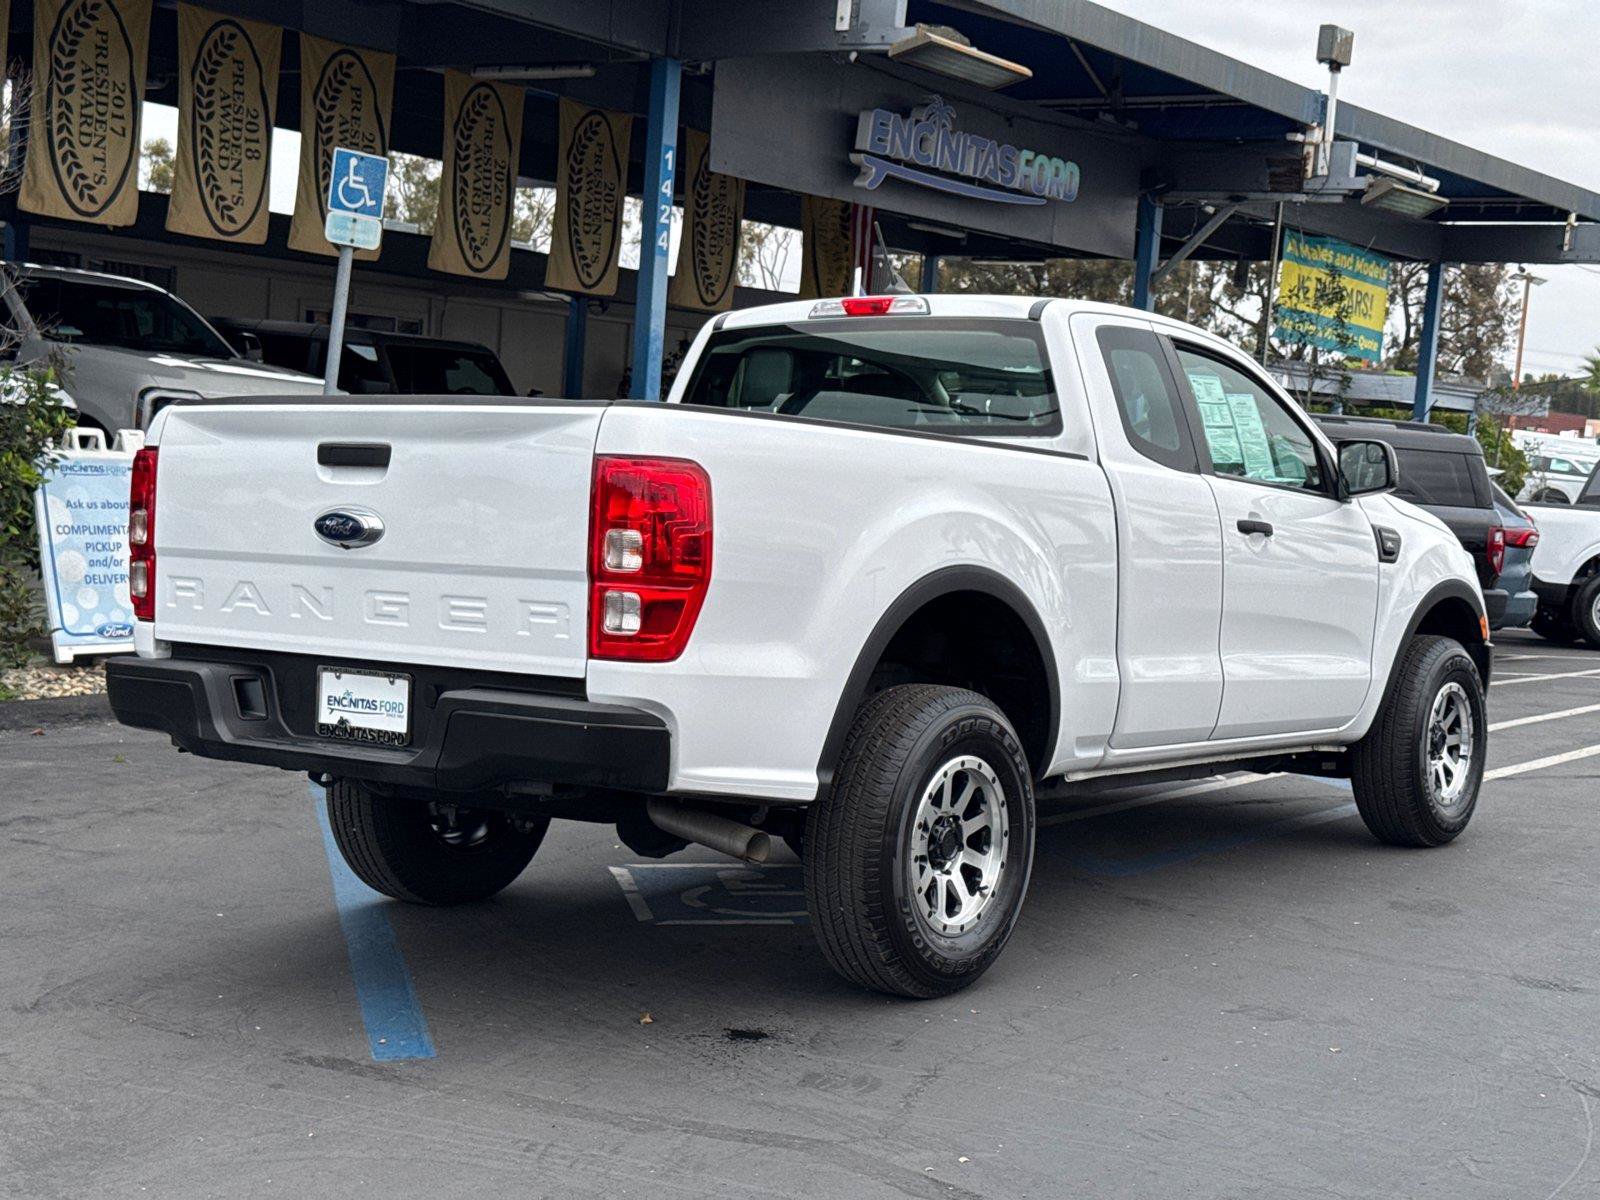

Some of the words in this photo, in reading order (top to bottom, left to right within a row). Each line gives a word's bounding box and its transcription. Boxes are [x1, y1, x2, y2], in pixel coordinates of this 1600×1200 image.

[79, 60, 95, 148] AWARD
[92, 29, 110, 186] PRESIDENT'S
[110, 82, 128, 138] 2017
[218, 88, 231, 171] AWARD
[231, 59, 246, 207] PRESIDENT'S
[245, 108, 261, 161] 2018
[864, 107, 1019, 189] ENCINITAS
[1018, 149, 1081, 203] FORD
[471, 142, 483, 216] AWARD
[479, 116, 495, 247] PRESIDENT'S
[582, 169, 595, 235] AWARD
[591, 142, 605, 264] PRESIDENT'S
[603, 181, 616, 226] 2021
[656, 149, 675, 252] 1424
[1335, 251, 1353, 270] and
[1355, 255, 1388, 281] Models
[60, 464, 105, 473] ENCINITAS
[66, 499, 84, 510] Ask
[86, 501, 98, 510] us
[100, 499, 130, 510] about
[85, 541, 122, 552] PICKUP
[88, 557, 124, 568] and/or
[102, 624, 131, 638] Ford
[166, 574, 572, 639] RANGER
[327, 695, 378, 711] ENCINITAS
[379, 701, 405, 715] FORD
[377, 731, 406, 746] FORD
